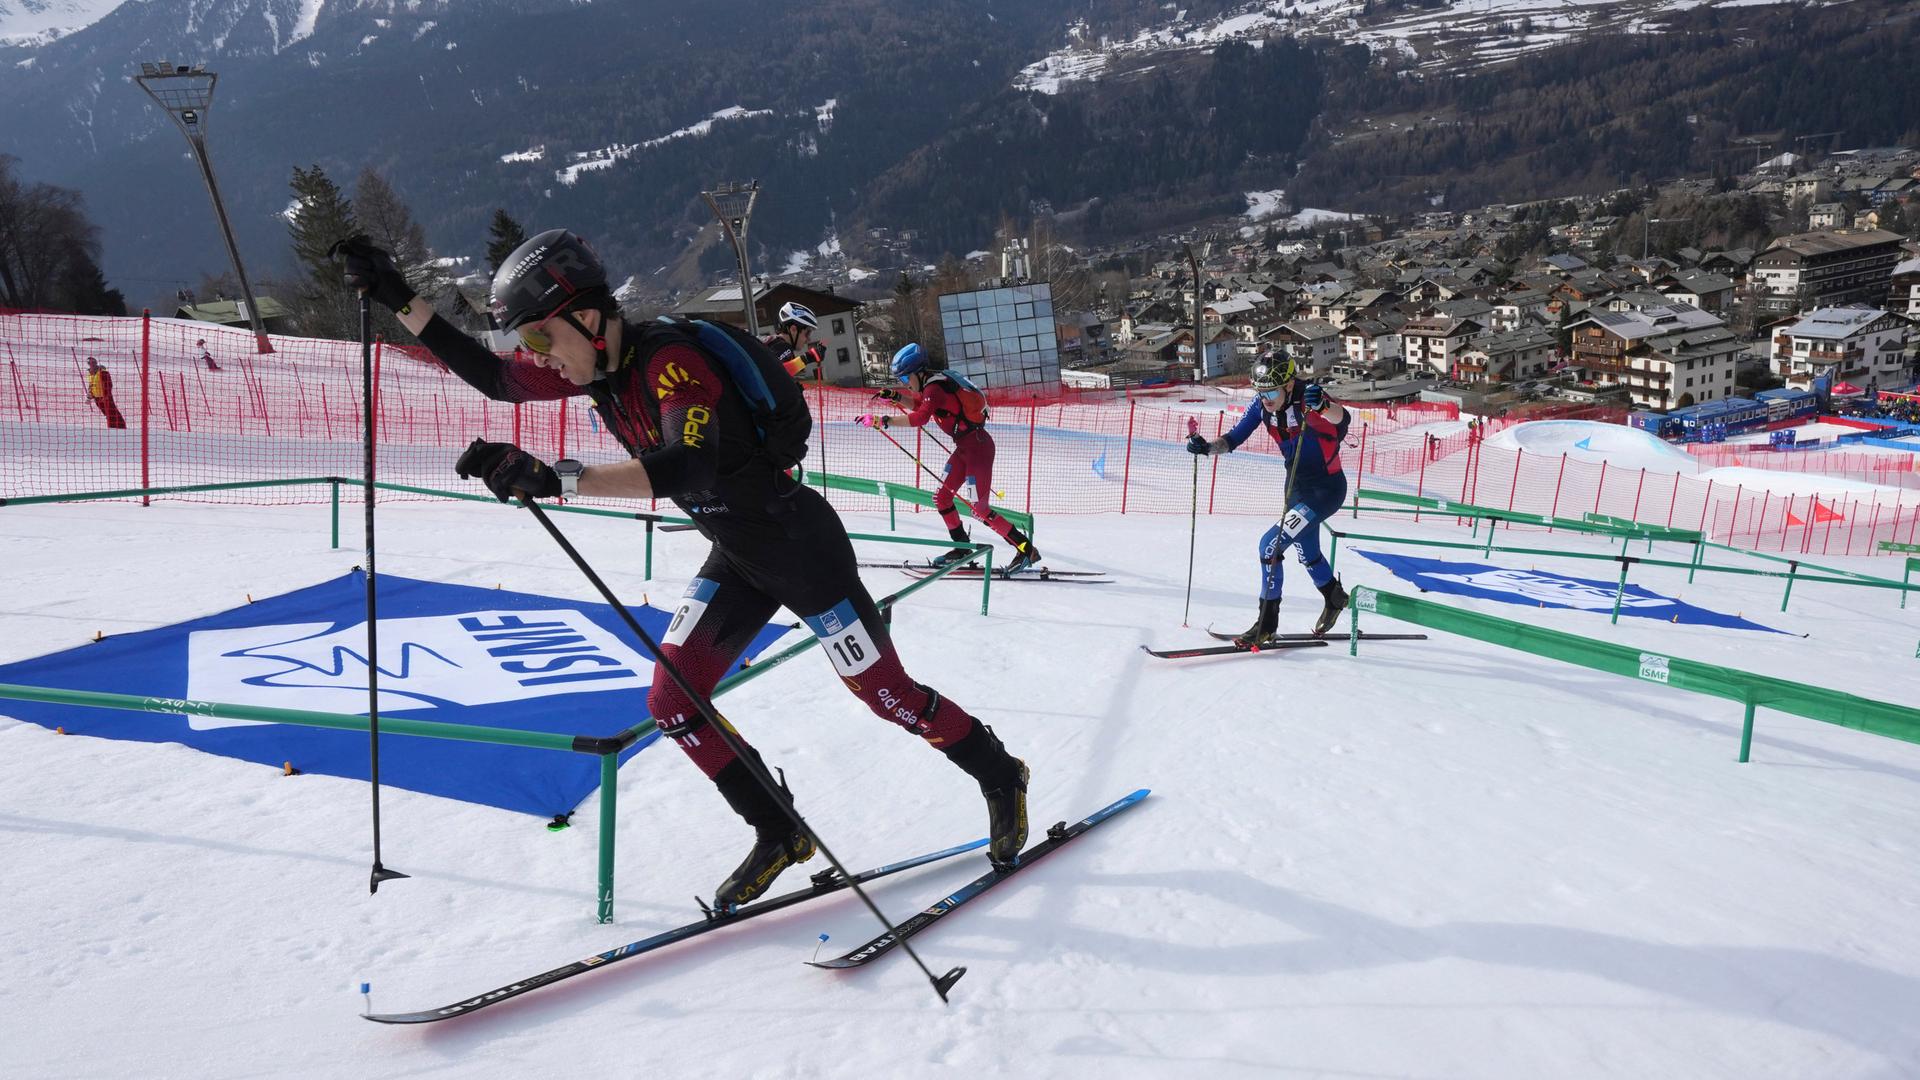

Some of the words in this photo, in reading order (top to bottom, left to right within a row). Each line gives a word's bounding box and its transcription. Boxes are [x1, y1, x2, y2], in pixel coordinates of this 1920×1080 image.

[1284, 513, 1302, 530] 20
[669, 604, 690, 633] 6
[457, 615, 638, 687] ISMF
[833, 634, 865, 667] 16
[1640, 667, 1668, 680] ISMF
[736, 885, 757, 902] LA
